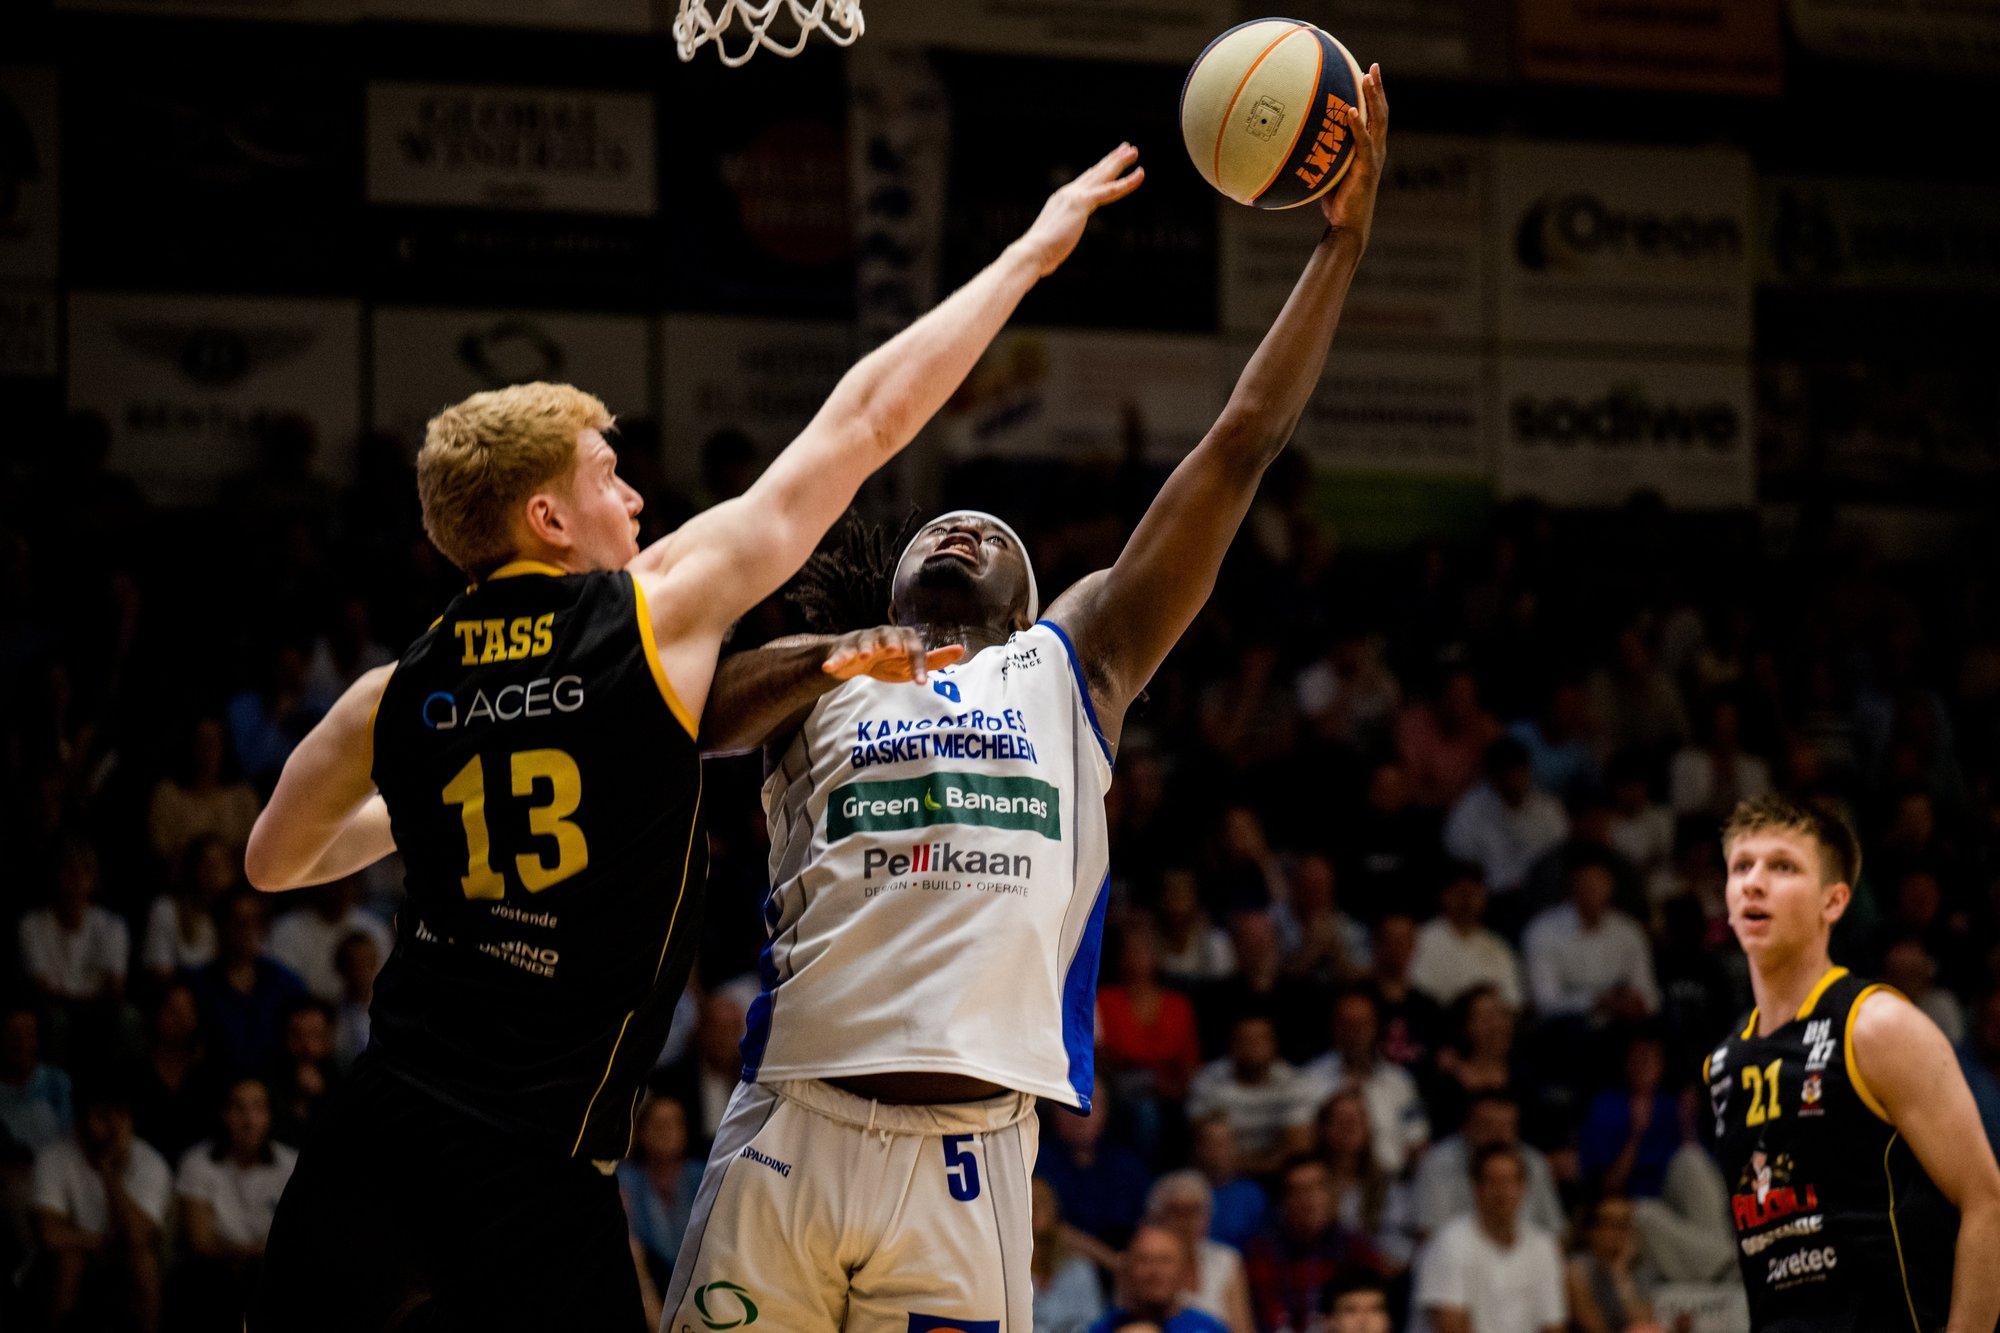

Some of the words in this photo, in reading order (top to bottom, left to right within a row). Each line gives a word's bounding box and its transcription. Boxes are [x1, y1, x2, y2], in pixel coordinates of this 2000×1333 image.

[1295, 93, 1352, 189] BNXT
[454, 612, 555, 666] TASS
[464, 674, 584, 727] ACEG
[851, 734, 930, 769] BASKET
[933, 732, 1038, 765] MECHELEN
[442, 748, 588, 900] 13
[842, 796, 919, 819] Green
[946, 786, 1048, 819] Bananas
[864, 842, 1032, 880] Pellikaan
[864, 881, 907, 898] DESIGN
[922, 880, 961, 891] BUILD
[976, 881, 1028, 897] OPERATE
[1741, 1058, 1783, 1128] 21
[741, 1146, 791, 1178] SPALDING
[942, 1133, 981, 1201] 5
